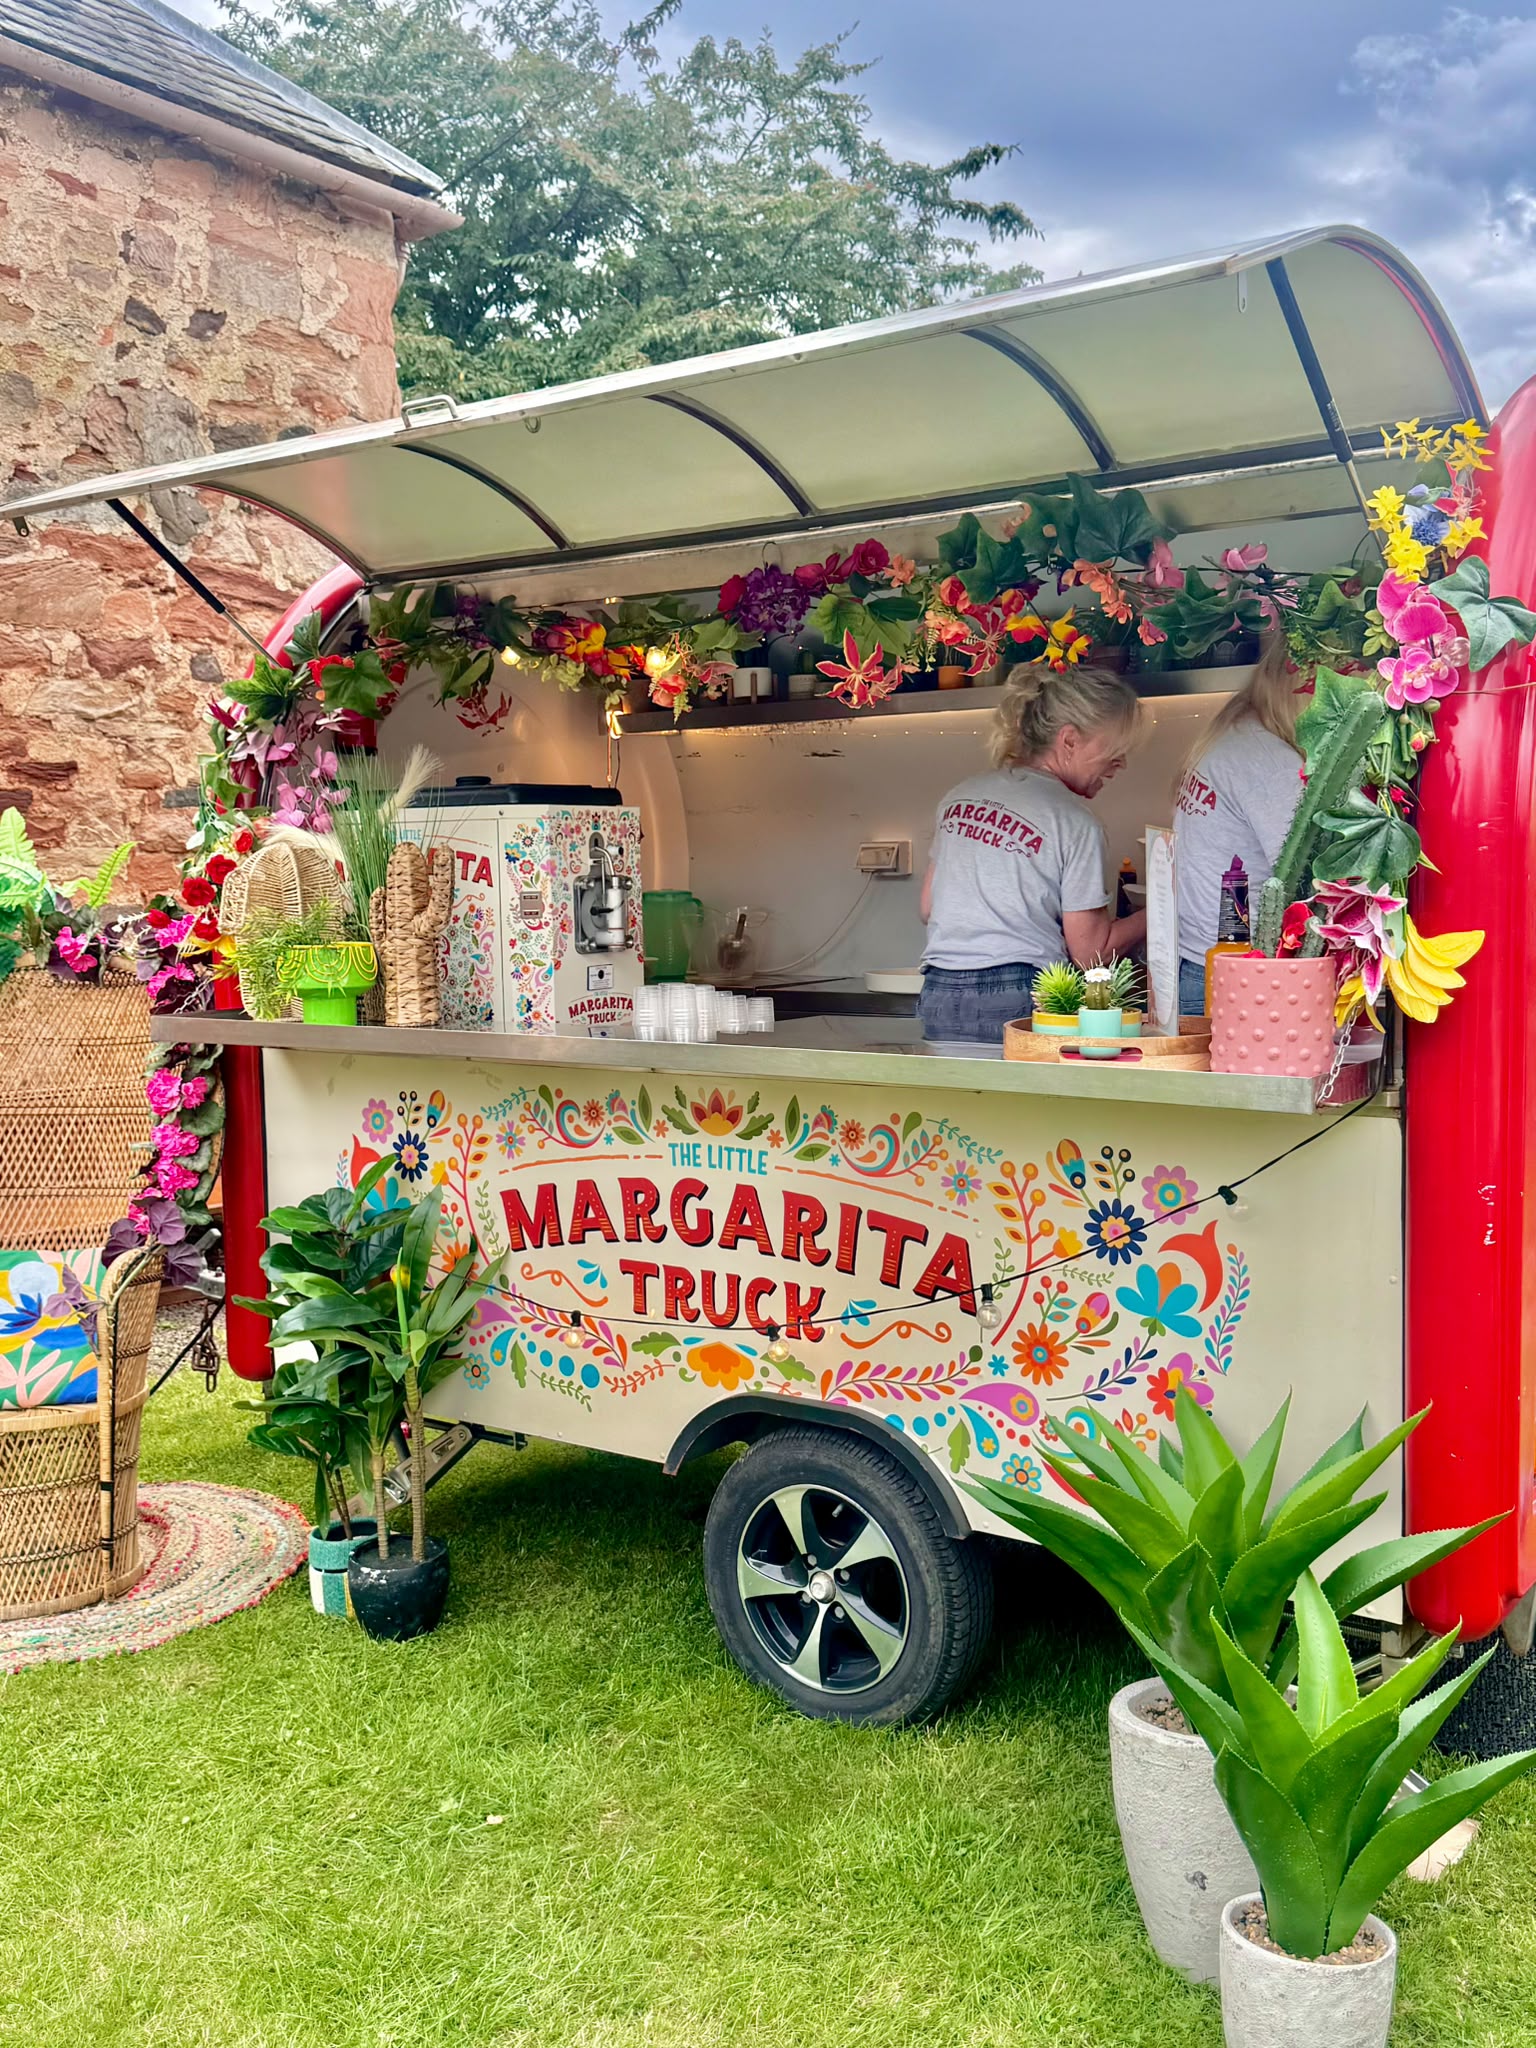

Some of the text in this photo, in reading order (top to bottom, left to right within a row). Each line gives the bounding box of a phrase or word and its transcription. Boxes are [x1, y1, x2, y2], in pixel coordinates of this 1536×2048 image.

[957, 821, 1003, 848] TRUCK
[568, 996, 633, 1018] MARGARITA
[587, 1011, 616, 1024] TRUCK
[668, 1142, 769, 1175] THE LITTLE
[499, 1176, 978, 1317] MARGARITA
[619, 1258, 826, 1343] TRUCK
